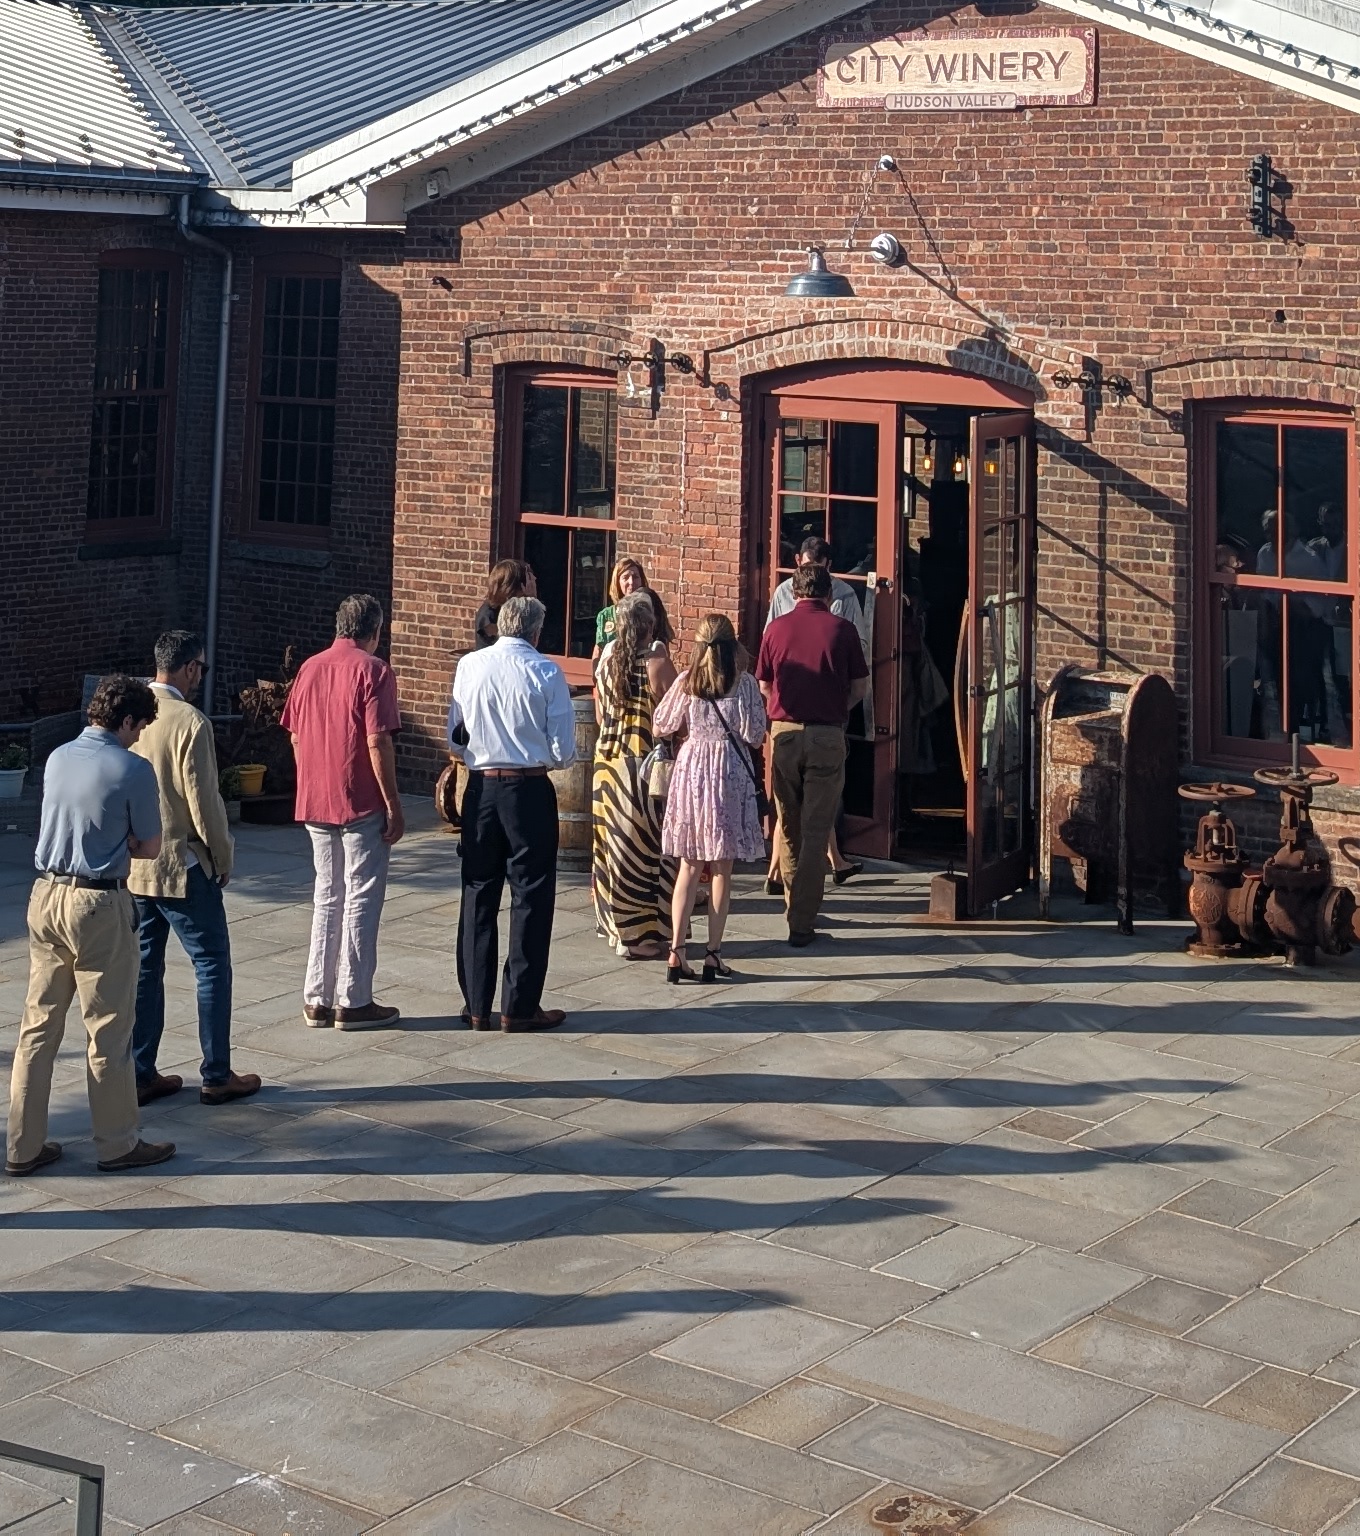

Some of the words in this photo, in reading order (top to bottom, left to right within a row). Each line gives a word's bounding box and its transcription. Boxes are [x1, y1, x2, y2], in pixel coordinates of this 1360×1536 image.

[836, 53, 914, 84] CITY
[924, 50, 1072, 84] WINERY
[893, 95, 953, 108] HUDSON
[957, 94, 1007, 107] VALLEY
